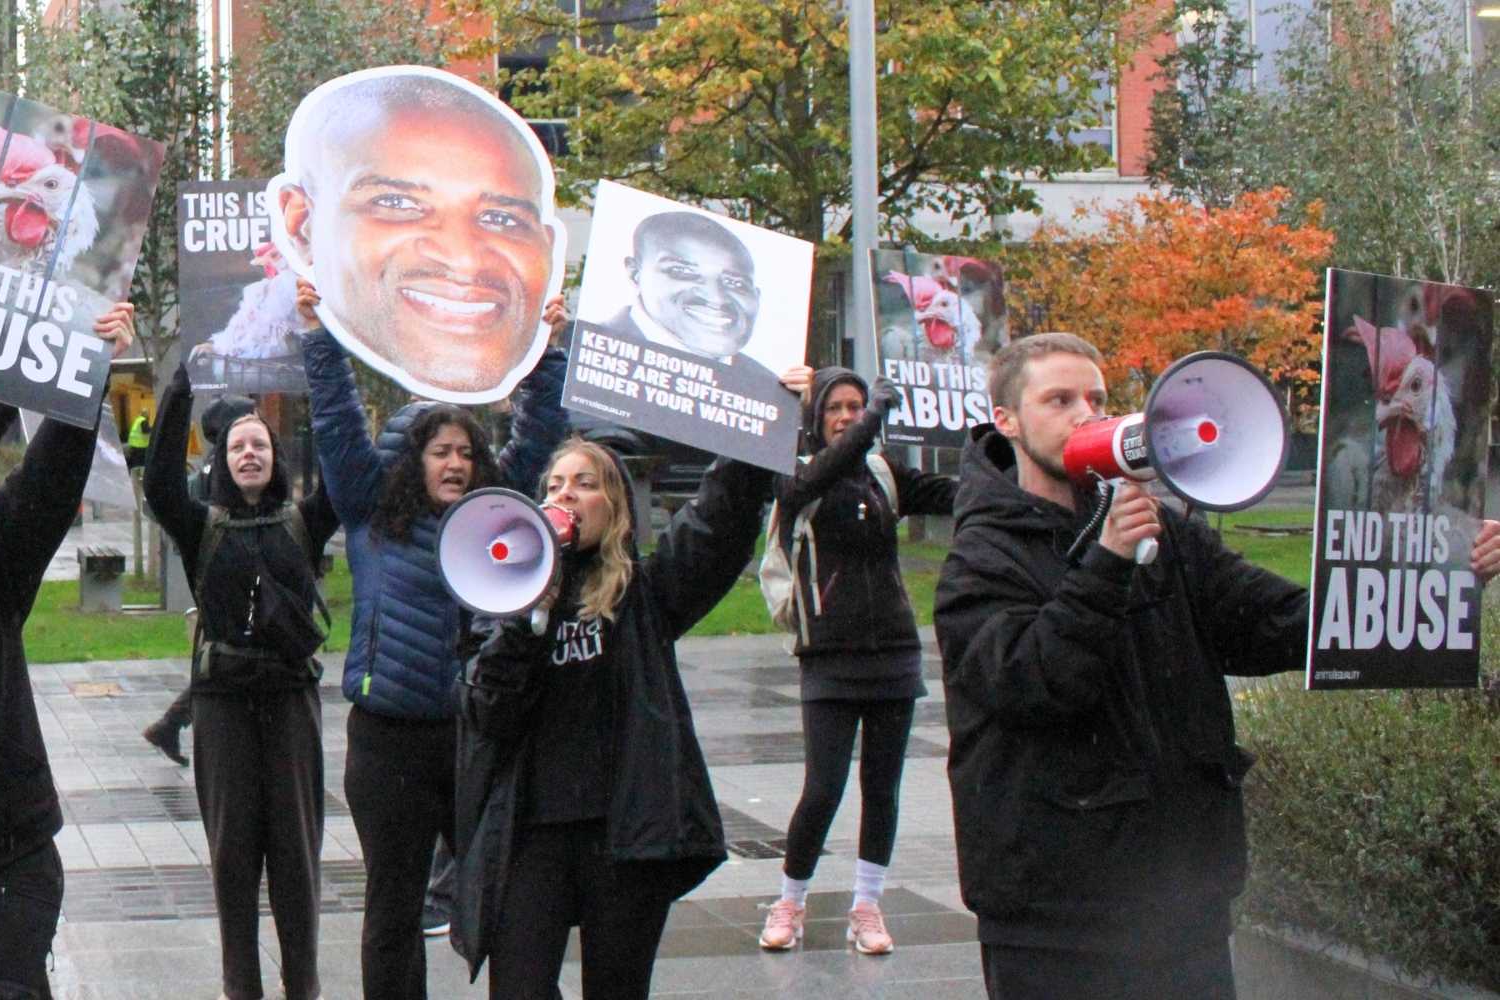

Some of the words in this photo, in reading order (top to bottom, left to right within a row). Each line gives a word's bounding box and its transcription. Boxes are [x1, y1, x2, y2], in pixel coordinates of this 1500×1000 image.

[183, 191, 240, 218] THIS
[247, 191, 270, 217] IS
[184, 218, 269, 252] CRUE
[578, 347, 629, 377] HENS
[631, 365, 671, 390] ARE
[675, 376, 779, 422] SUFFERING
[581, 329, 640, 361] KEVIN
[643, 348, 719, 387] BROWN,
[884, 358, 931, 387] END
[933, 361, 987, 391] THIS
[575, 364, 640, 399] UNDER
[643, 385, 695, 416] YOUR
[700, 402, 765, 437] WATCH
[887, 385, 995, 431] ABUS
[1325, 509, 1383, 562] END
[1388, 511, 1450, 565] THIS
[1316, 566, 1476, 651] ABUSE
